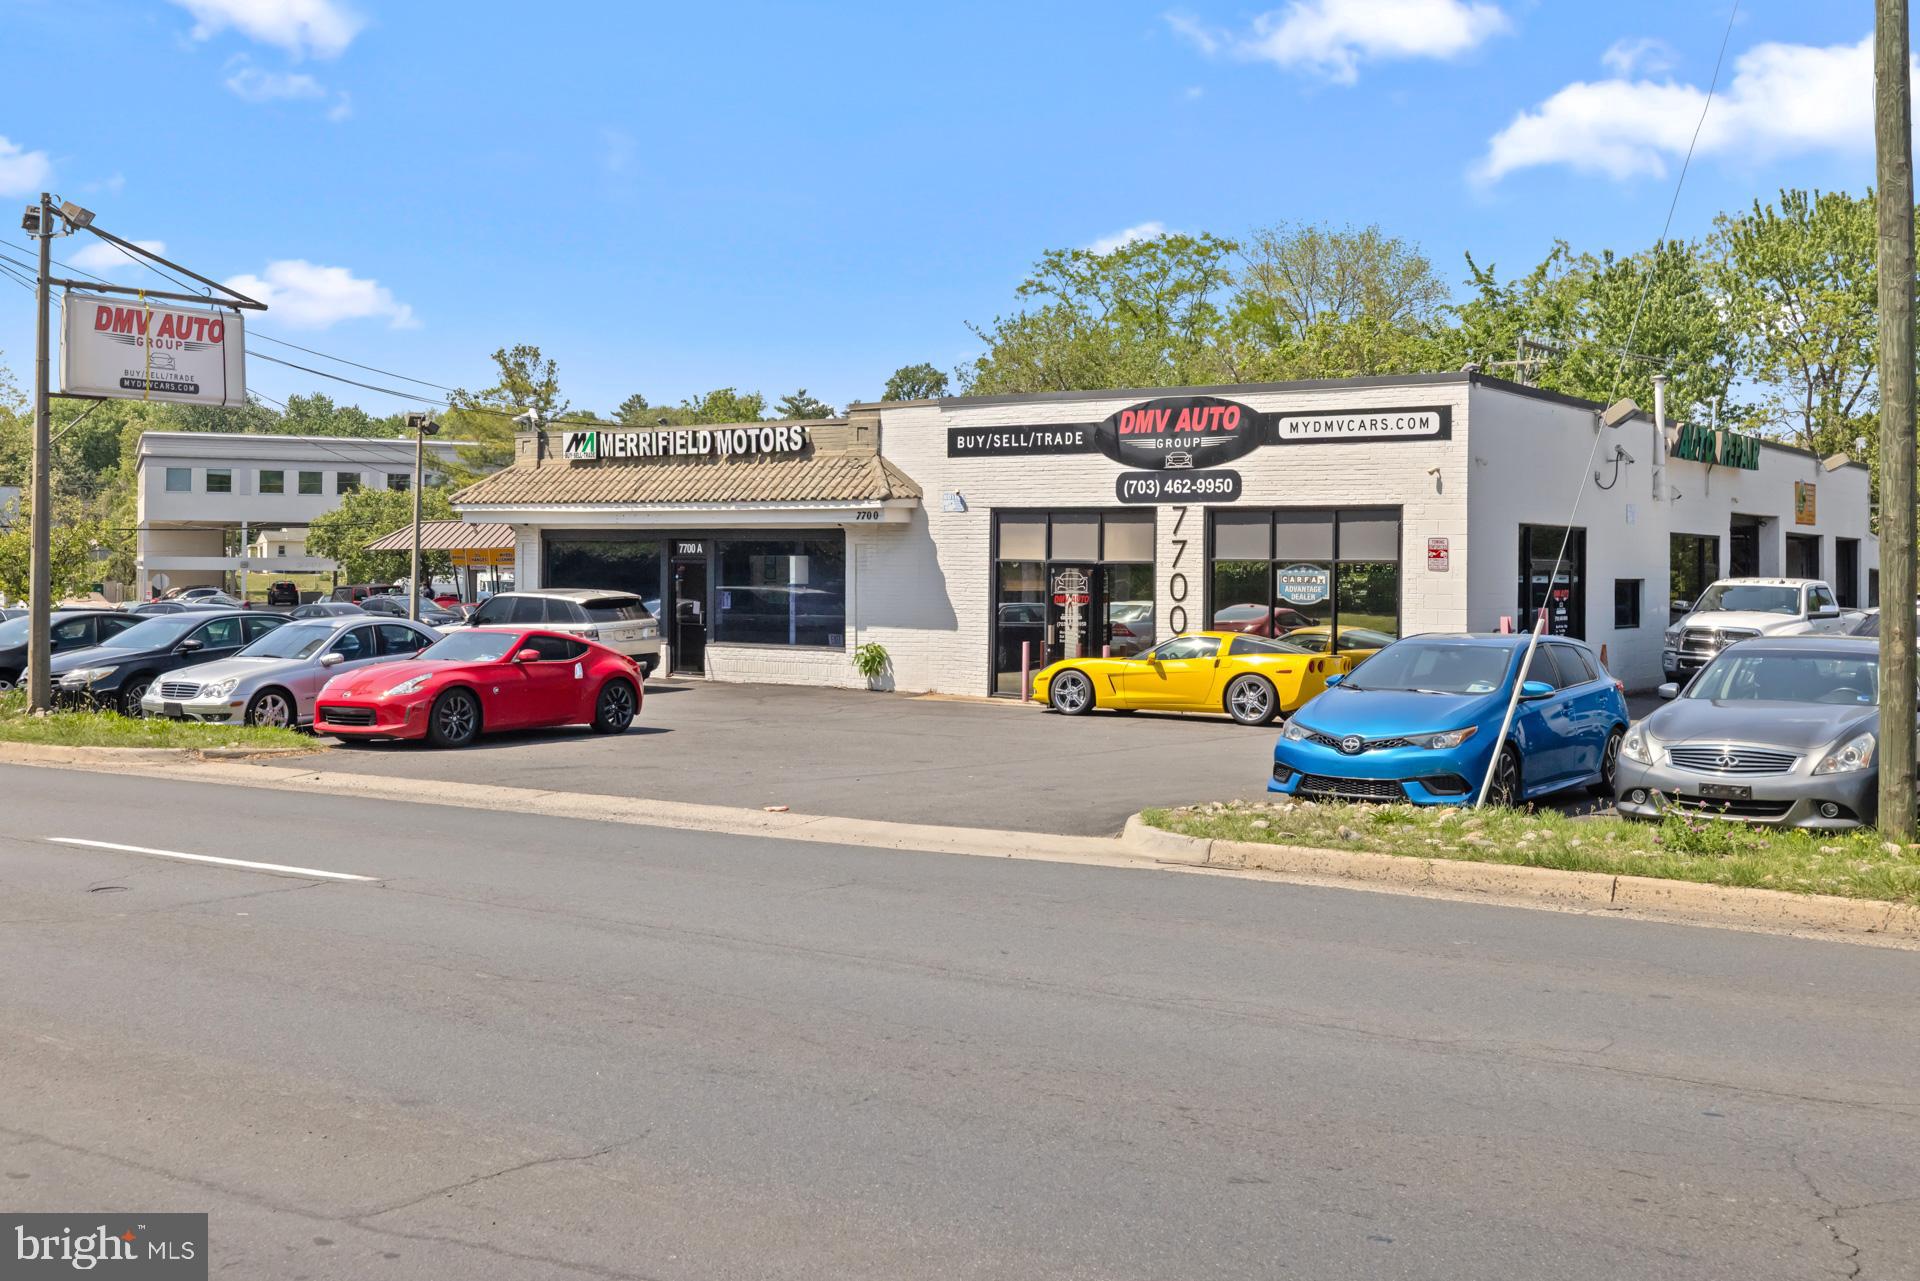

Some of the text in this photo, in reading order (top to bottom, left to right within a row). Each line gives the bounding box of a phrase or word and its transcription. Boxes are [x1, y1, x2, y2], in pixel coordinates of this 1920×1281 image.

[95, 305, 224, 343] DMV AUTO
[136, 337, 183, 350] GROUP
[124, 369, 195, 382] BUY/ELL/TRADE
[1119, 405, 1240, 434] DMV AUTO
[1289, 417, 1430, 434] MYDMVCARS.COM
[600, 425, 803, 457] MERRIFIELD MOTORS
[957, 431, 1083, 449] BUY/SELL/TRADE
[1156, 437, 1200, 448] GROUP
[1678, 421, 1760, 470] AUTO REPAIR
[1123, 478, 1233, 497] (703) 462-9950
[856, 511, 879, 520] 7700
[679, 543, 703, 553] 7700 A
[1169, 506, 1188, 635] 7700
[1282, 575, 1326, 584] CARFAX
[1285, 585, 1322, 593] ADVANTAGE
